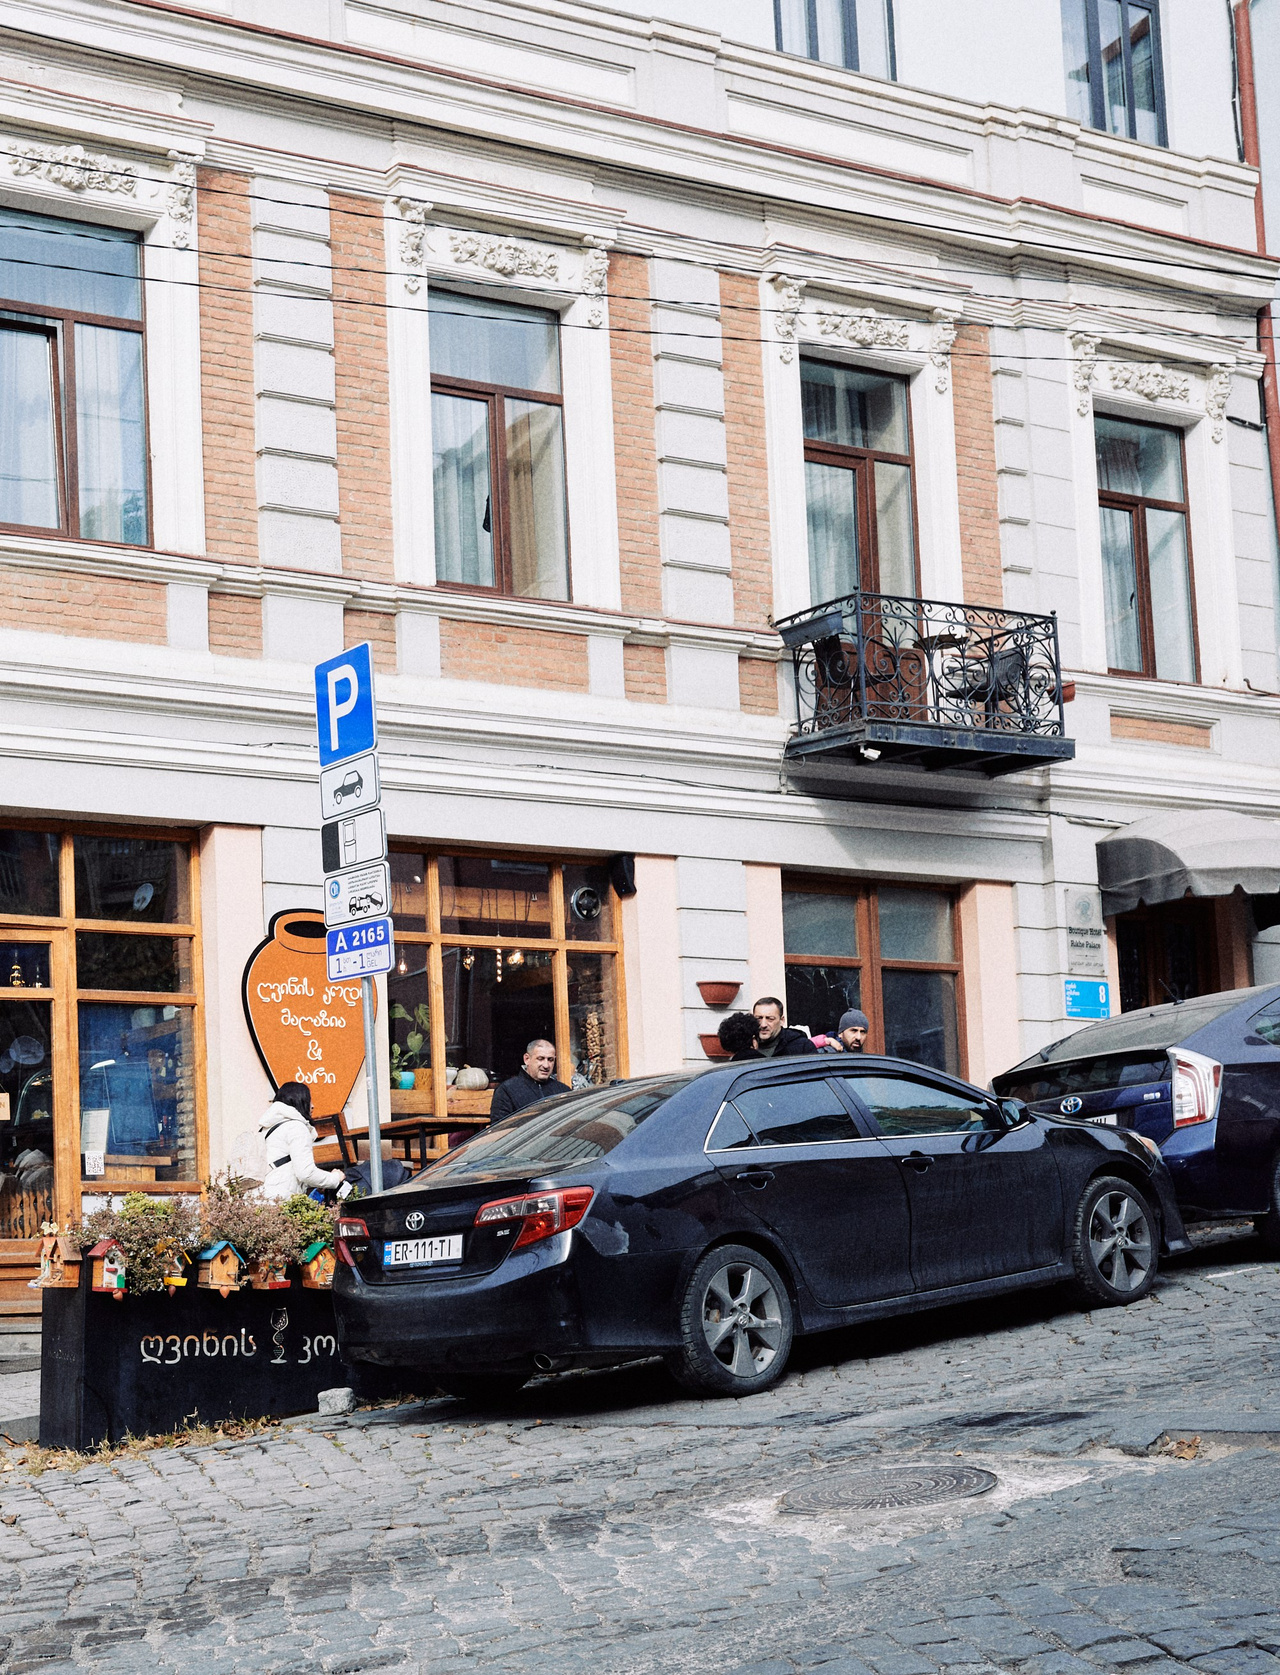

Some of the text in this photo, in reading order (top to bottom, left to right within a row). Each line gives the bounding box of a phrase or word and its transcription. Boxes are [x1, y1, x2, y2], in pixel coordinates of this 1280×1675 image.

[327, 664, 358, 751] P
[335, 925, 385, 952] A 2165
[257, 977, 363, 1007] ღვინის კოდ
[1098, 985, 1106, 1004] 8
[281, 1008, 346, 1036] მაღაზია
[306, 1039, 323, 1061] &
[295, 1066, 336, 1084] ბარი
[394, 1239, 451, 1262] ER-111-TI
[140, 1327, 336, 1364] ღვინის კო
